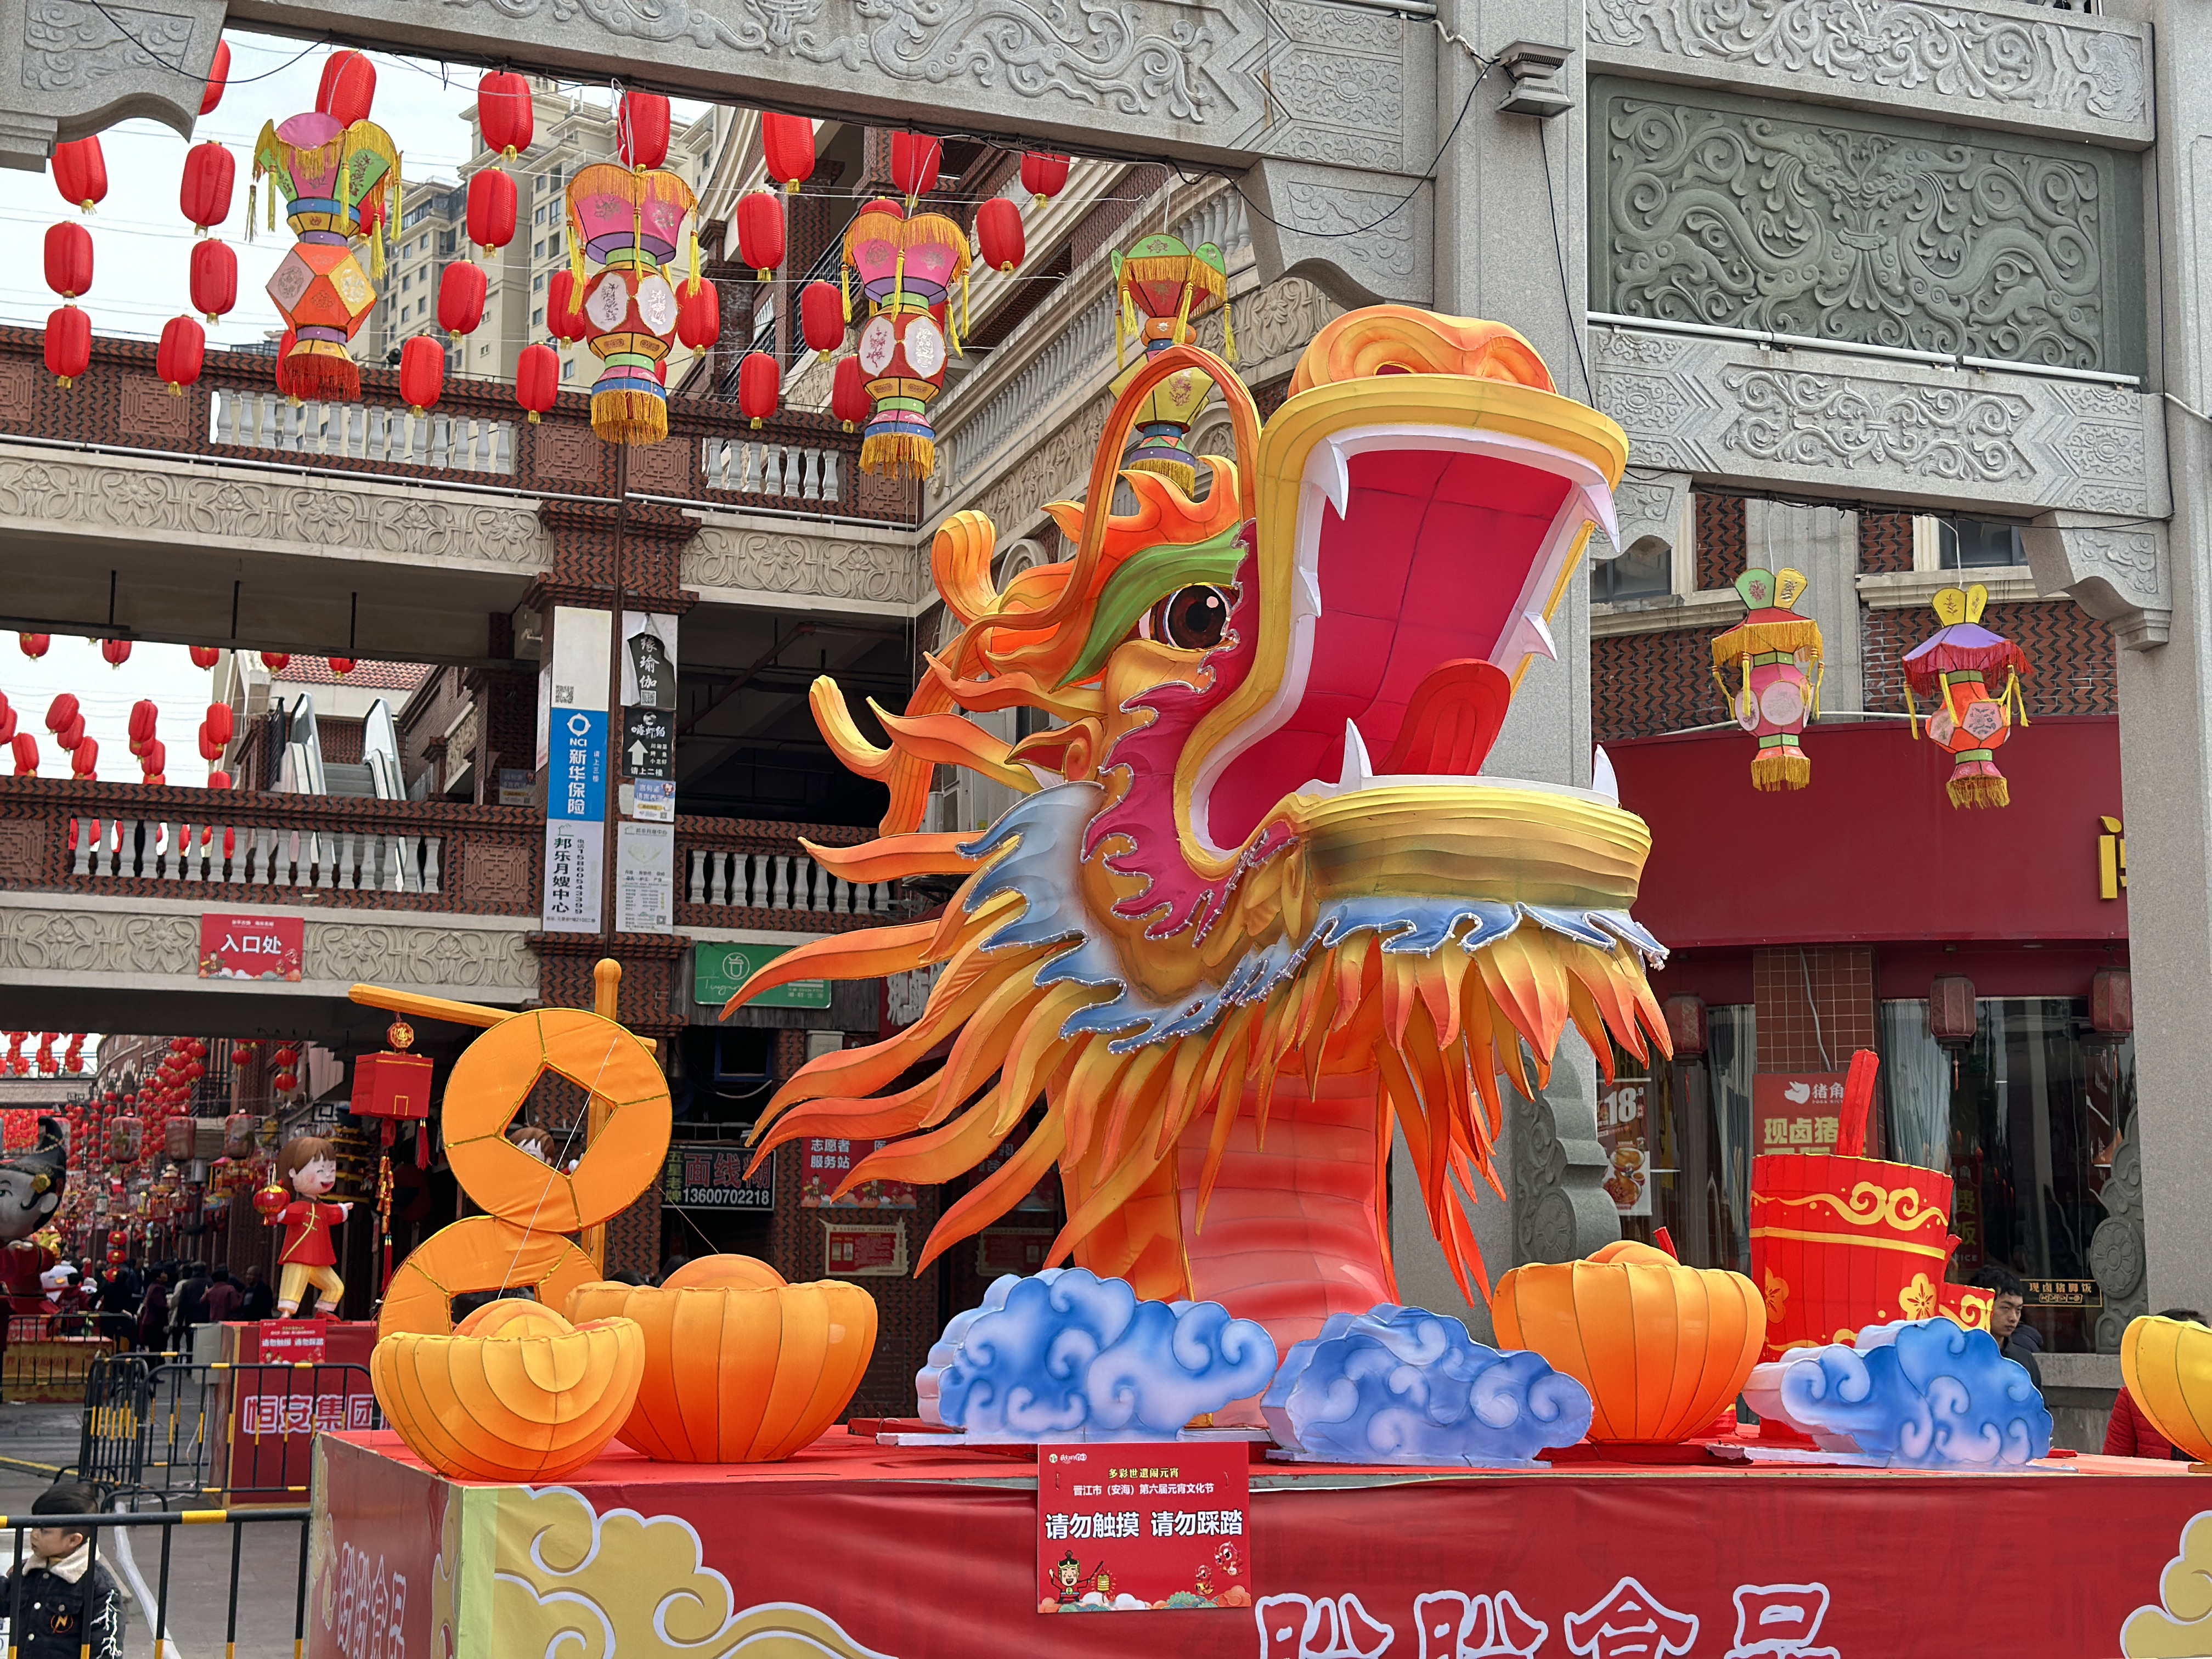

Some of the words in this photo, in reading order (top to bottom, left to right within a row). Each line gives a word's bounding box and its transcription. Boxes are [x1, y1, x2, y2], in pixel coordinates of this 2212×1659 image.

[569, 738, 587, 747] NCI
[631, 766, 663, 777] 请上二楼
[567, 749, 587, 815] 新华保险
[551, 837, 572, 913] 邦乐月嫂中心
[221, 934, 281, 954] 入口处
[1764, 1116, 1839, 1144] 现卤猪
[811, 1139, 850, 1153] 志愿者
[810, 1155, 850, 1169] 服务站
[683, 1188, 770, 1205] 13600702218
[1109, 1468, 1180, 1479] 多彩世遗闹元宵
[1045, 1511, 1139, 1540] 请勿触摸
[1150, 1509, 1243, 1537] 请勿踩踏
